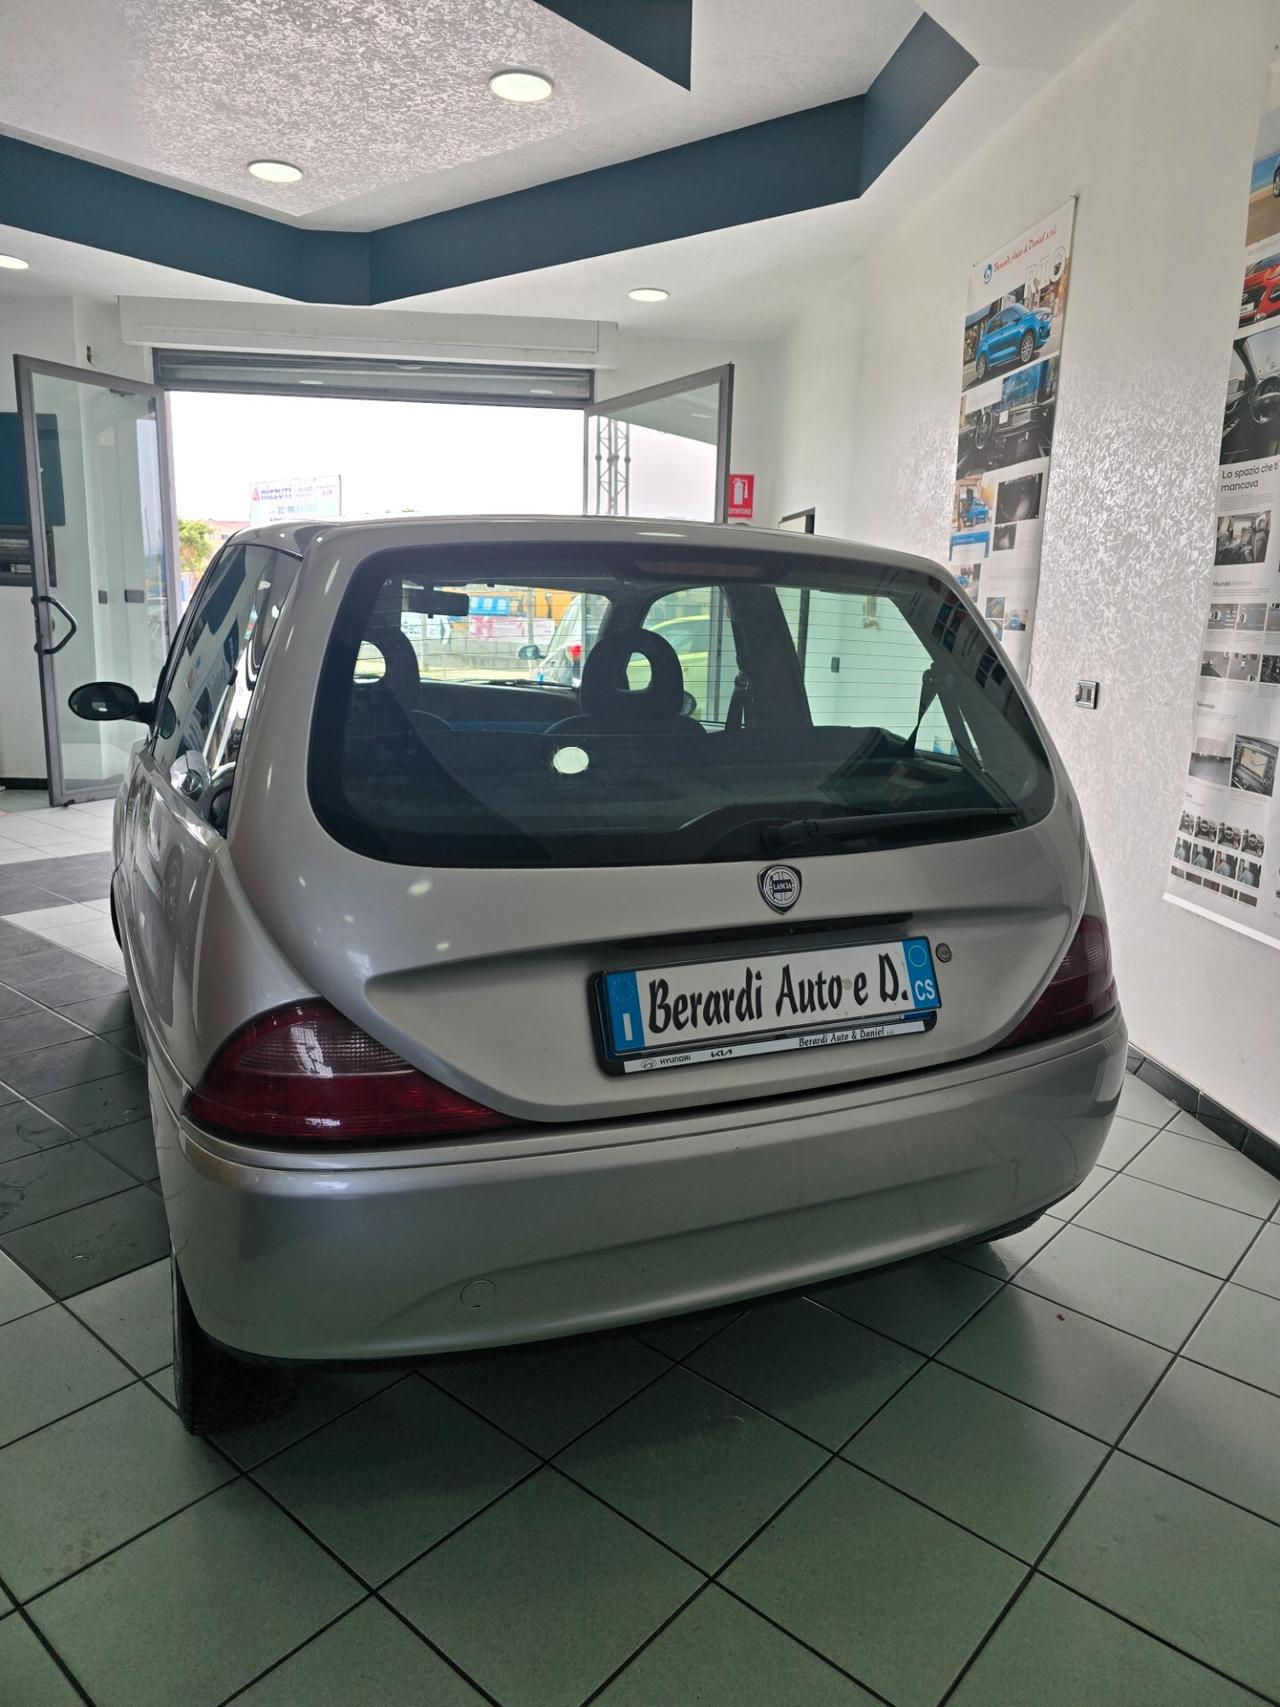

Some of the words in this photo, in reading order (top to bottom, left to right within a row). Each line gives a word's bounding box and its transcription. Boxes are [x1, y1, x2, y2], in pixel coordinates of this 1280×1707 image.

[1025, 246, 1066, 292] RIO
[1222, 470, 1233, 479] Lo
[1234, 465, 1260, 479] spazio
[1261, 463, 1273, 473] che
[1221, 480, 1259, 491] mancava
[773, 882, 792, 890] LANCIA
[648, 966, 763, 1034] Berardi
[775, 963, 843, 1017] Auto
[853, 971, 868, 1006] e
[878, 952, 909, 1002] D.
[914, 979, 935, 1001] CS
[799, 1034, 828, 1047] Berardi
[830, 1033, 849, 1043] Auto
[851, 1030, 857, 1040] &
[860, 1027, 885, 1039] Daniel
[659, 1055, 692, 1065] HYUNDAI
[711, 1049, 733, 1058] KIA
